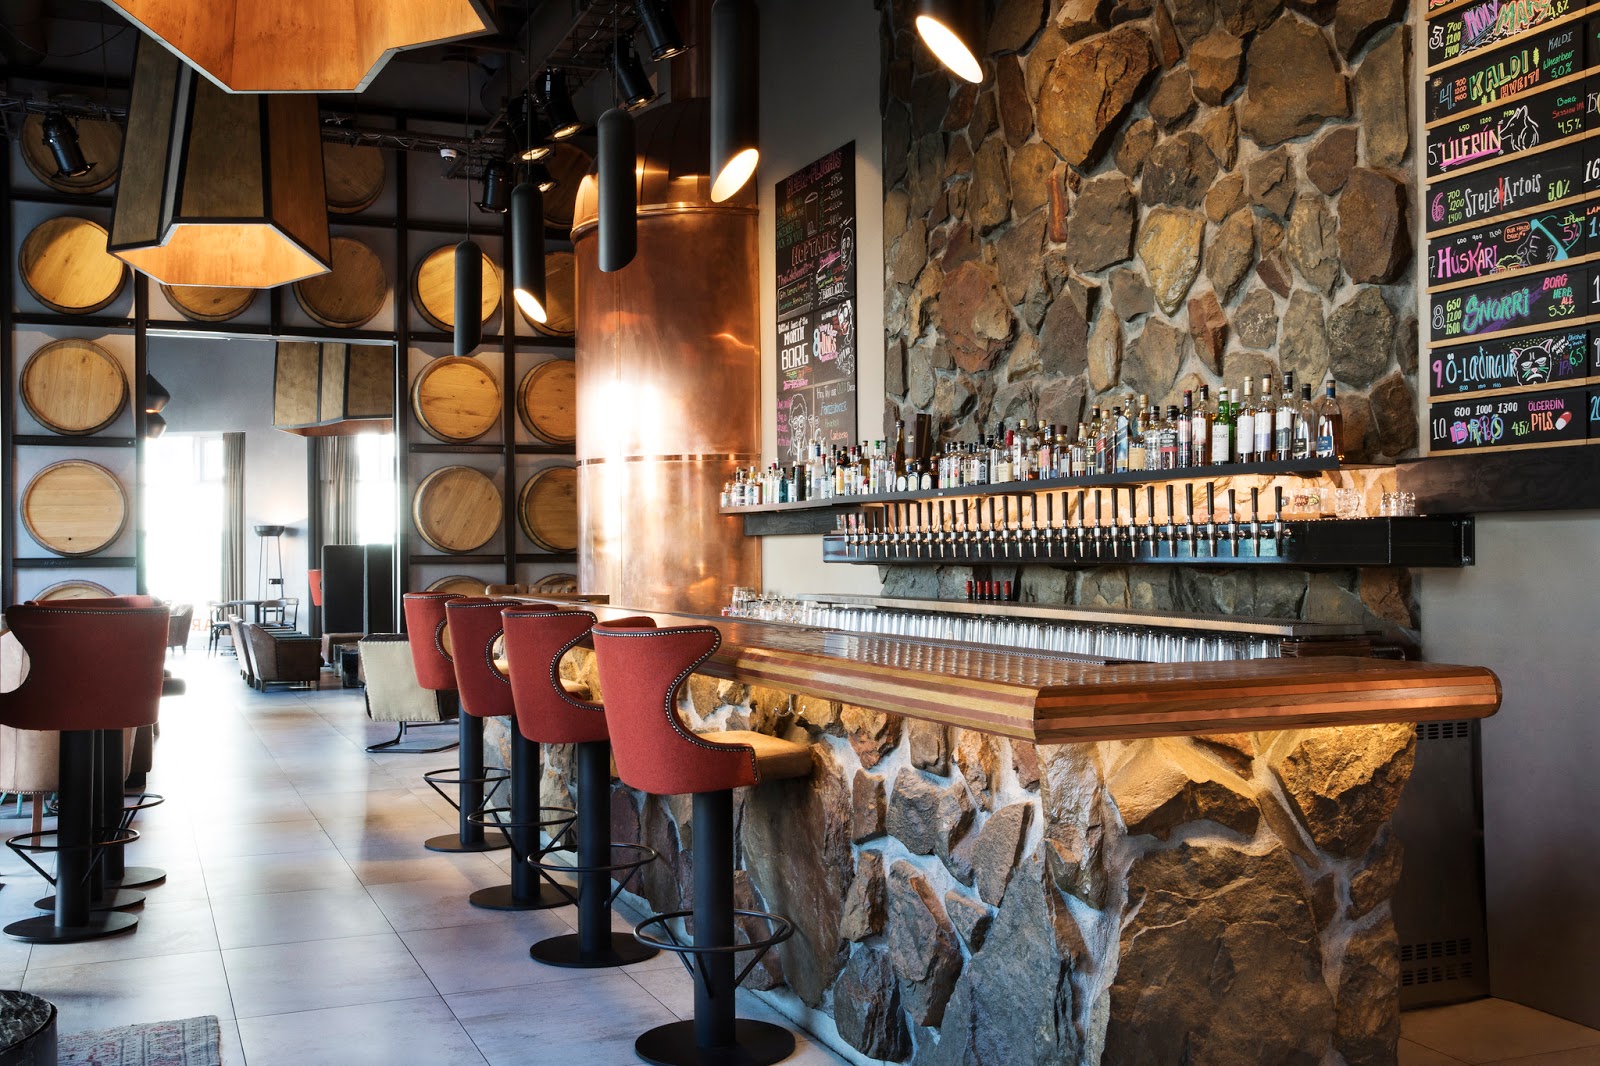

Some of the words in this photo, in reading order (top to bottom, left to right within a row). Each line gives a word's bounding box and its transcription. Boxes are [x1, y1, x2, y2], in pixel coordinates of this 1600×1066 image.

[1447, 22, 1462, 33] 700
[1548, 31, 1573, 52] KALDI
[1469, 50, 1529, 100] KALDI
[1447, 189, 1460, 203] 700
[1503, 173, 1542, 206] Artois
[1543, 273, 1568, 291] BORG
[1446, 297, 1461, 312] 650
[1561, 294, 1574, 306] ALE
[784, 326, 805, 346] MONTH
[781, 342, 809, 371] BORG
[1454, 406, 1470, 417] 600
[1475, 404, 1492, 415] 1000
[1498, 402, 1518, 414] 1300
